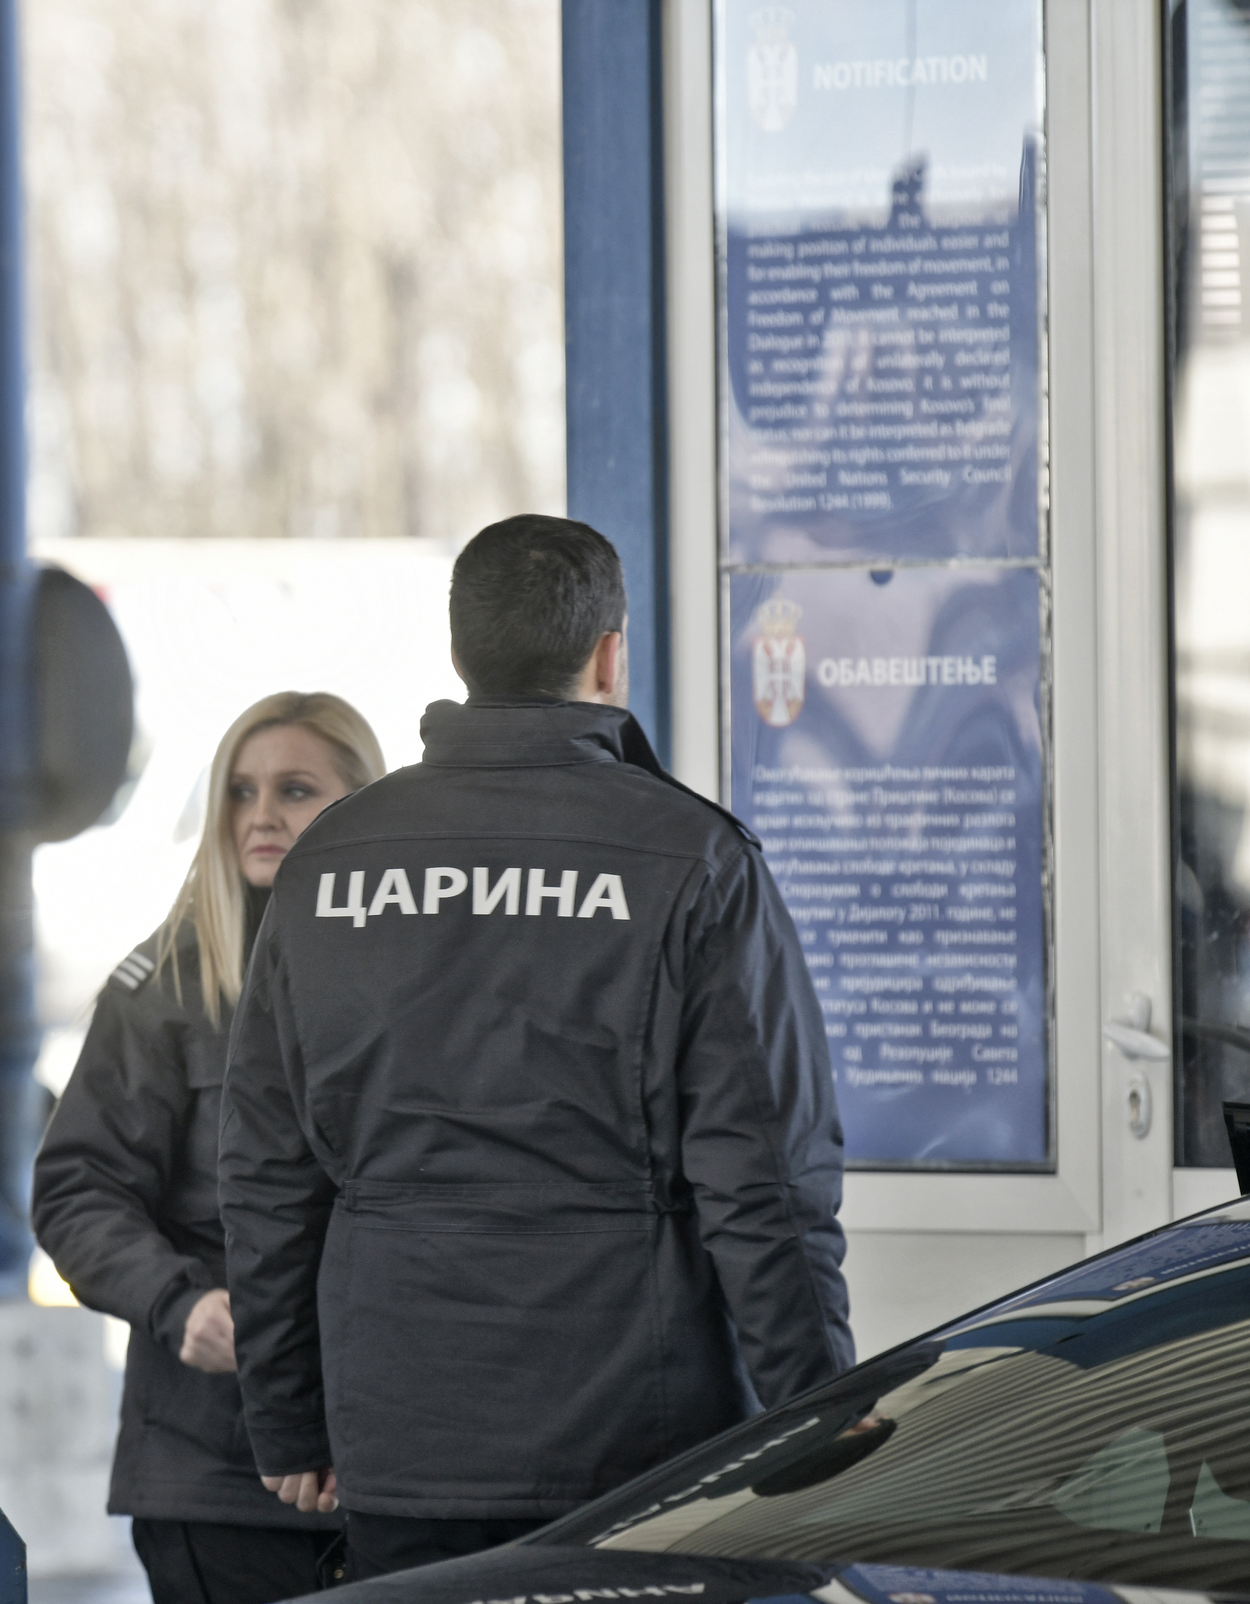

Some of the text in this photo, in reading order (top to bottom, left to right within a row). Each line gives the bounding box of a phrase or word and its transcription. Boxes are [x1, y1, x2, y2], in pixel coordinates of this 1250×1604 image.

[812, 54, 988, 91] NOTIFICATION
[984, 232, 1009, 248] and
[830, 284, 859, 301] with
[872, 283, 894, 299] the
[907, 280, 978, 302] Agreement
[991, 282, 1009, 295] on
[809, 309, 824, 325] of
[832, 306, 899, 324] Movement
[907, 303, 959, 321] reached
[967, 303, 980, 319] in
[987, 301, 1009, 318] the
[919, 327, 935, 343] be
[940, 324, 1009, 346] interpreted
[837, 398, 913, 420] determining
[838, 469, 888, 486] Nations
[900, 468, 951, 488] Security
[963, 466, 1012, 483] Council
[818, 655, 997, 687] ОБАВЕШТЕЊЕ
[945, 787, 998, 807] (Косова)
[1001, 790, 1015, 803] се
[315, 867, 631, 928] ЦАРИНА
[850, 904, 907, 924] Дијалогу
[1000, 907, 1016, 920] не
[898, 930, 924, 943] као
[937, 930, 1016, 947] признавање
[938, 1001, 955, 1014] не
[960, 1001, 996, 1014] може
[1003, 1001, 1018, 1014] се
[1001, 1024, 1018, 1036] на
